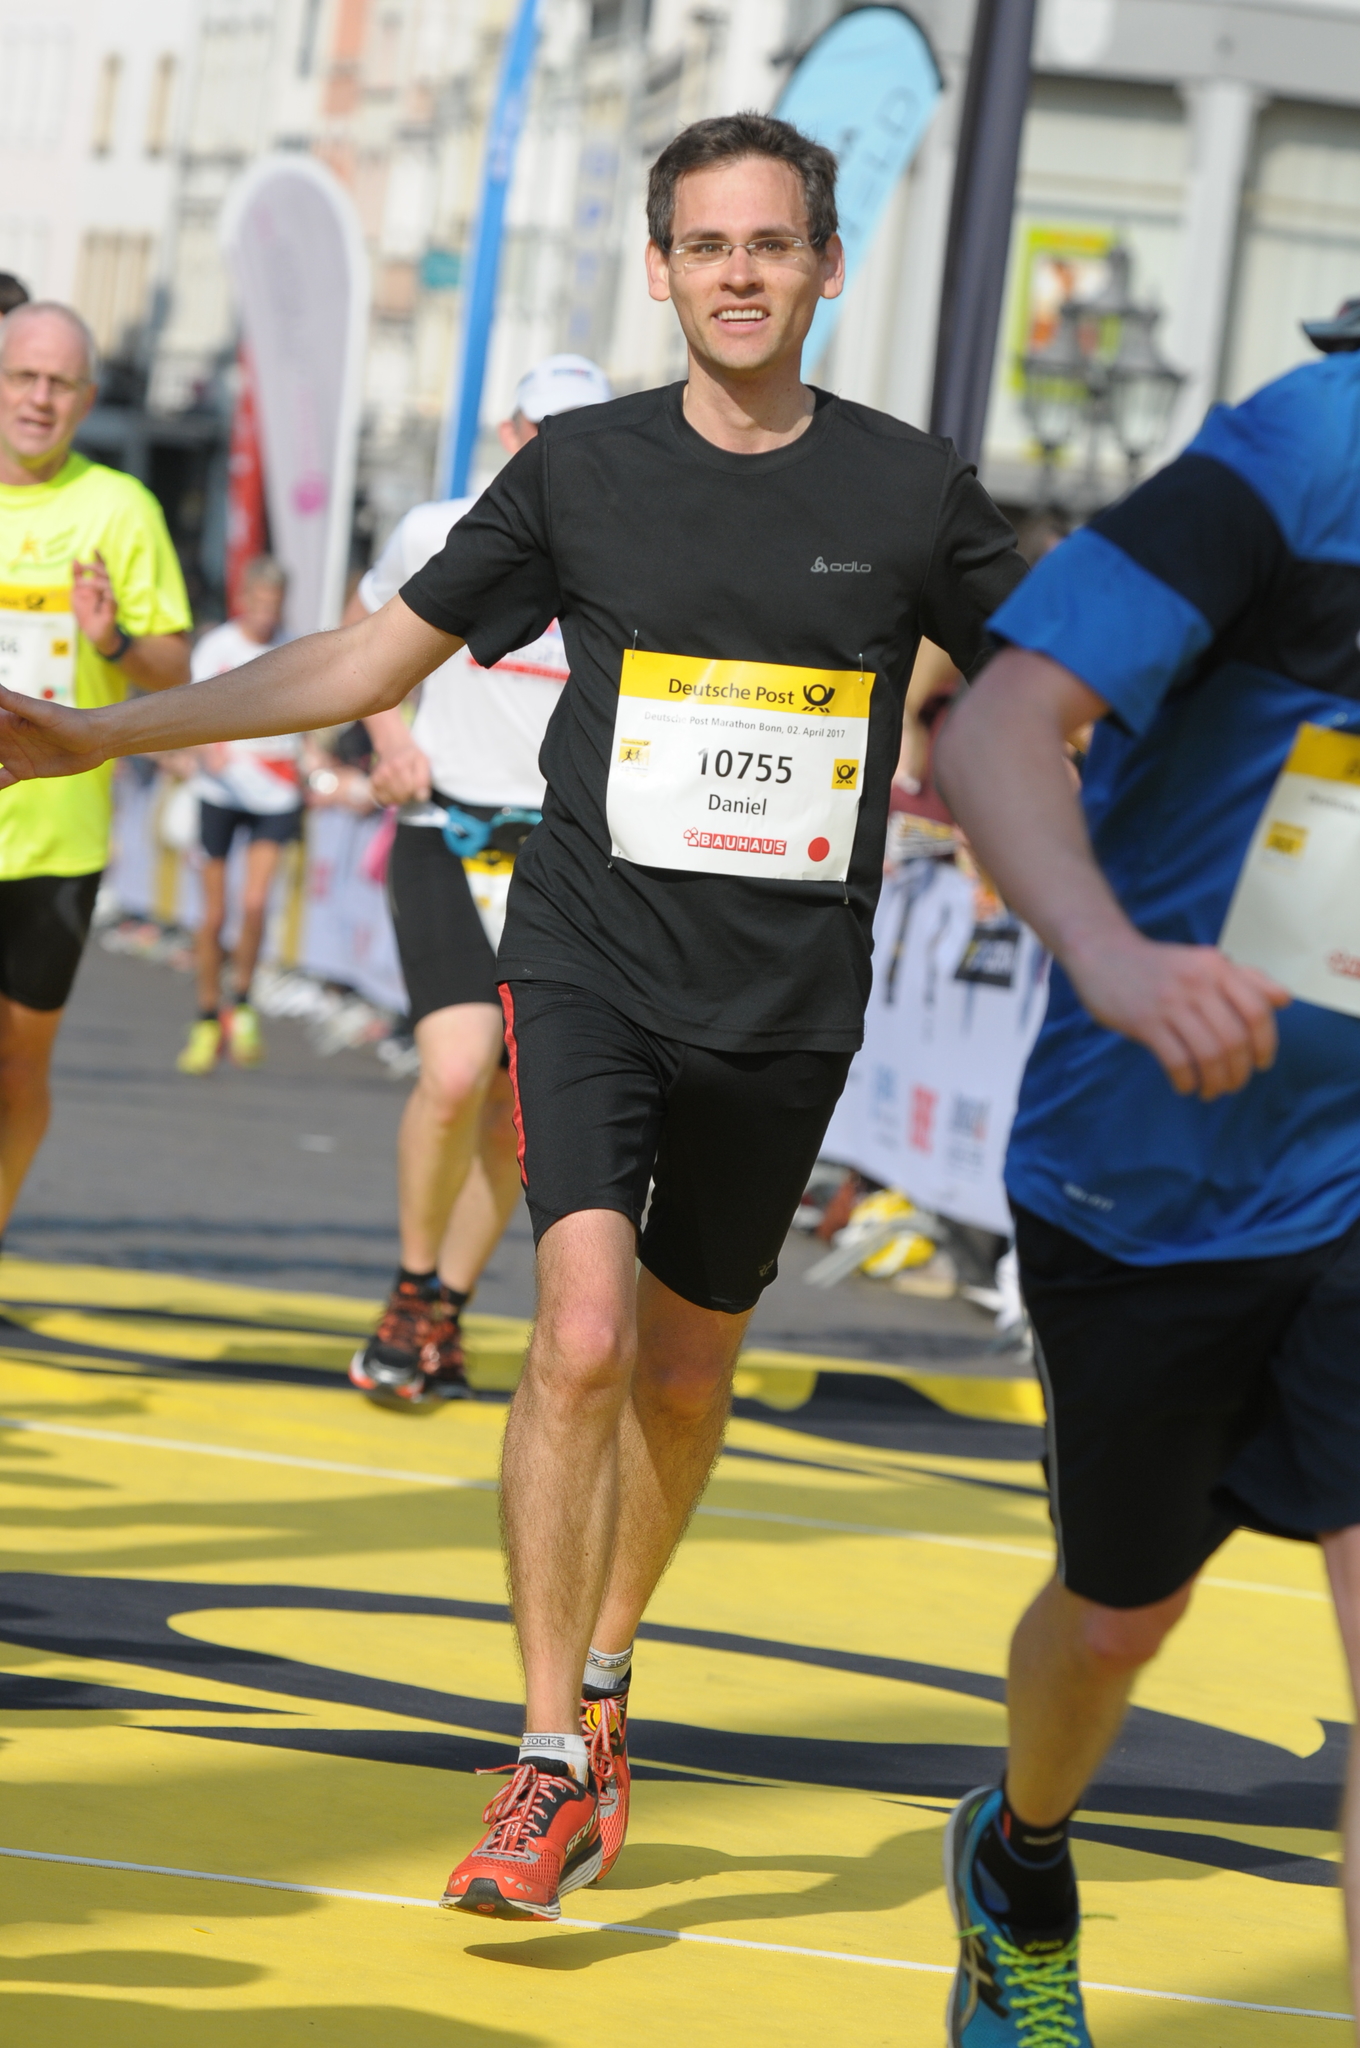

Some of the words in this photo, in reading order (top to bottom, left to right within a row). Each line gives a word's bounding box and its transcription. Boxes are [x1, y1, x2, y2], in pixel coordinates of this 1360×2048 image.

[829, 560, 872, 573] odlo
[668, 678, 751, 700] Deutsche
[755, 686, 795, 705] Post
[644, 711, 687, 725] Deutsche
[689, 716, 709, 726] Post
[711, 717, 756, 730] Marathon
[758, 722, 785, 735] Bonn,
[786, 725, 801, 736] 02.
[802, 727, 825, 739] April
[826, 728, 846, 739] 2017
[697, 747, 793, 784] 10755
[708, 793, 768, 816] Daniel
[700, 832, 787, 855] BAUHAUS
[526, 1737, 566, 1747] SOCKS
